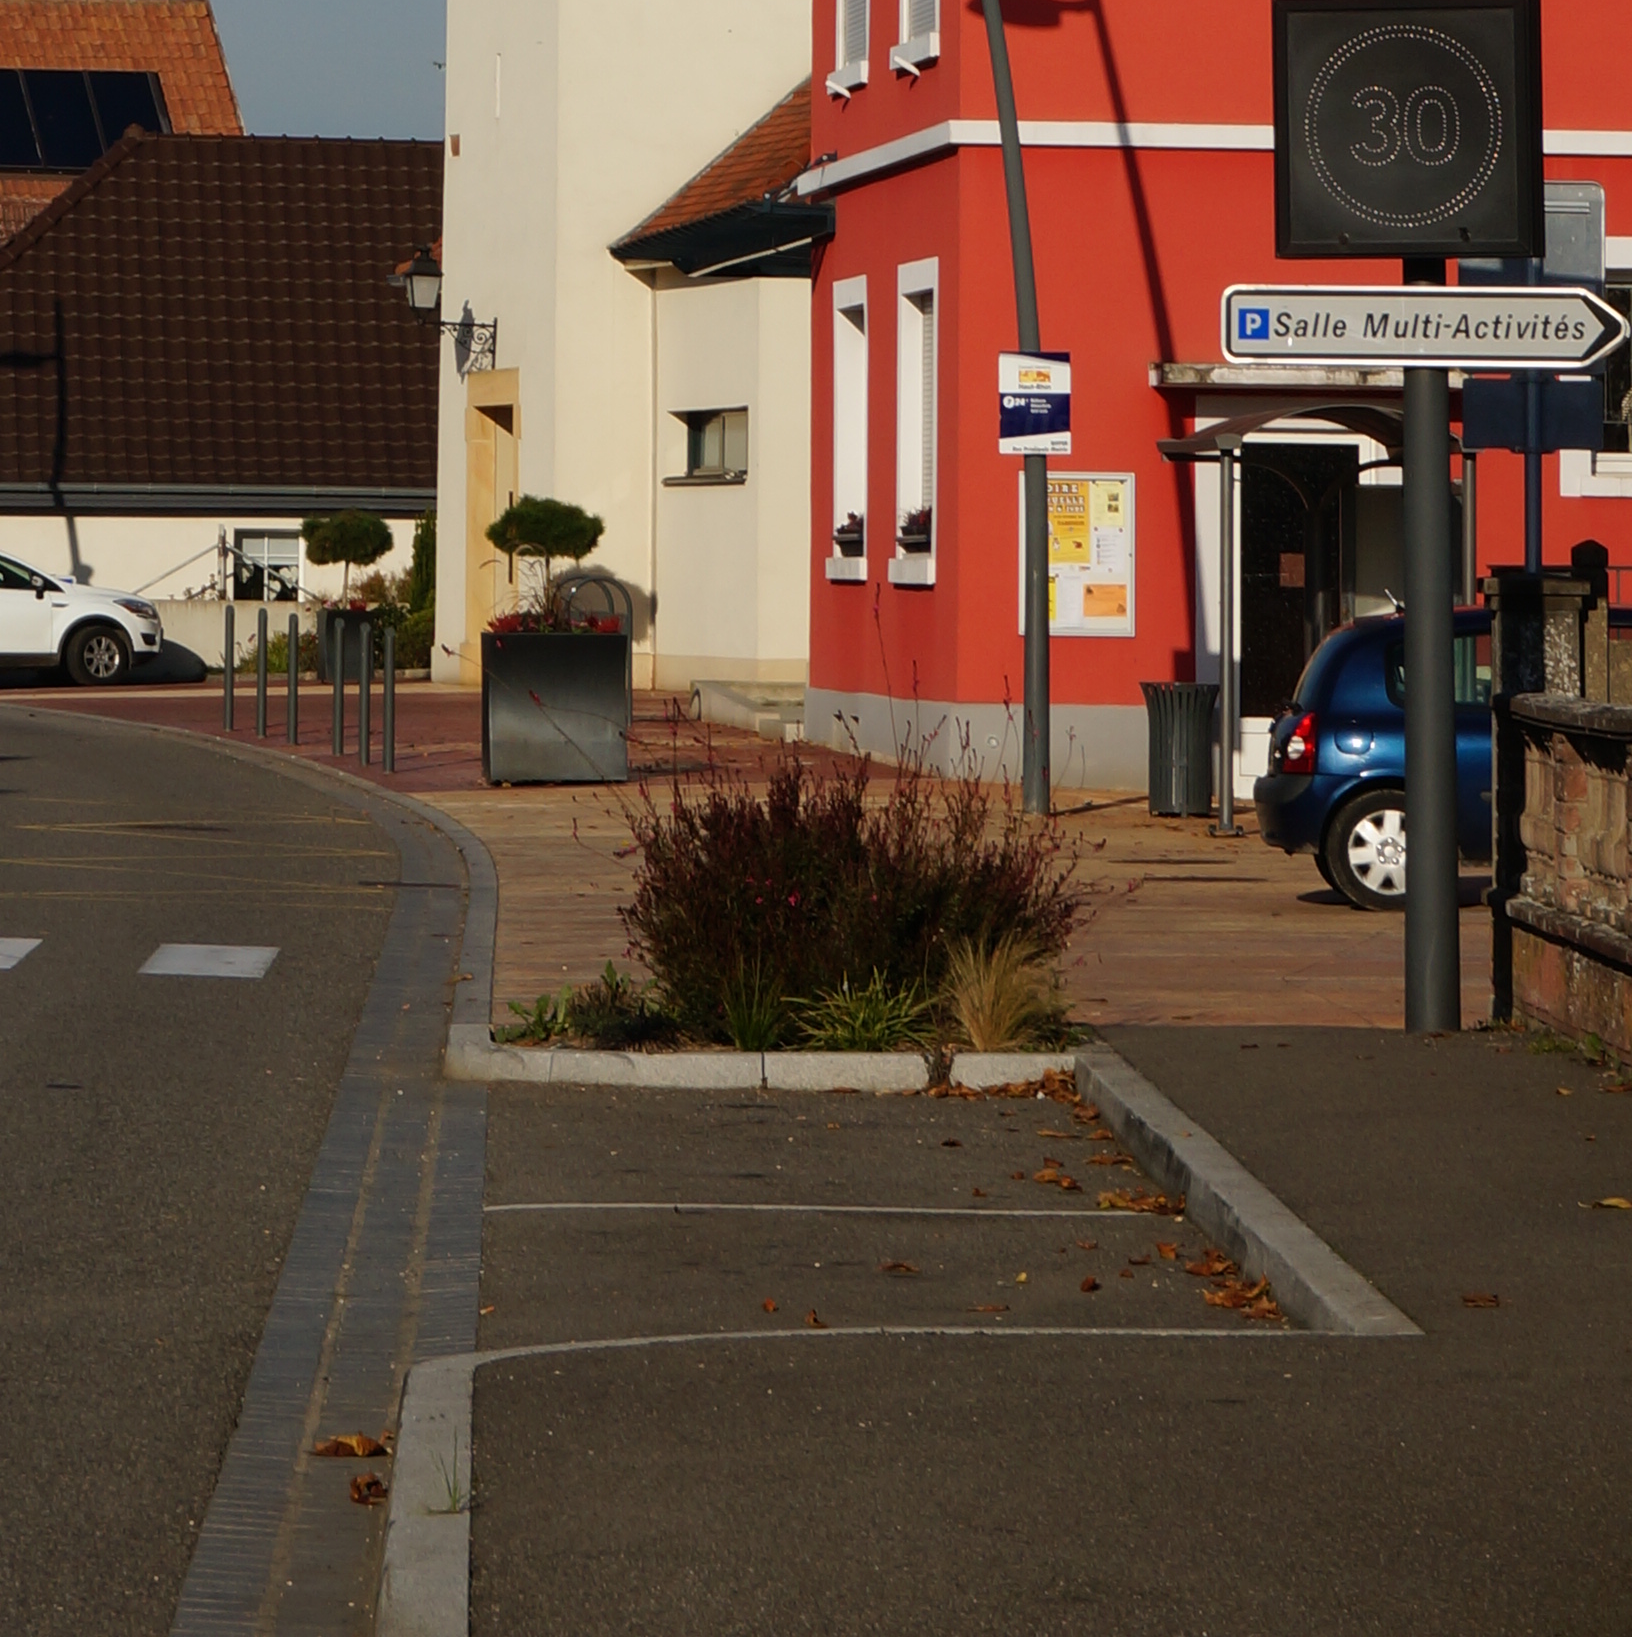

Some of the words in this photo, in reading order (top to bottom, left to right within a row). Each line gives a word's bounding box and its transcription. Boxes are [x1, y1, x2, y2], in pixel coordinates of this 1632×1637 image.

[1349, 84, 1460, 167] 30
[1274, 311, 1347, 338] Salle
[1363, 312, 1586, 340] Multi-Activités
[1047, 483, 1078, 493] OIRE
